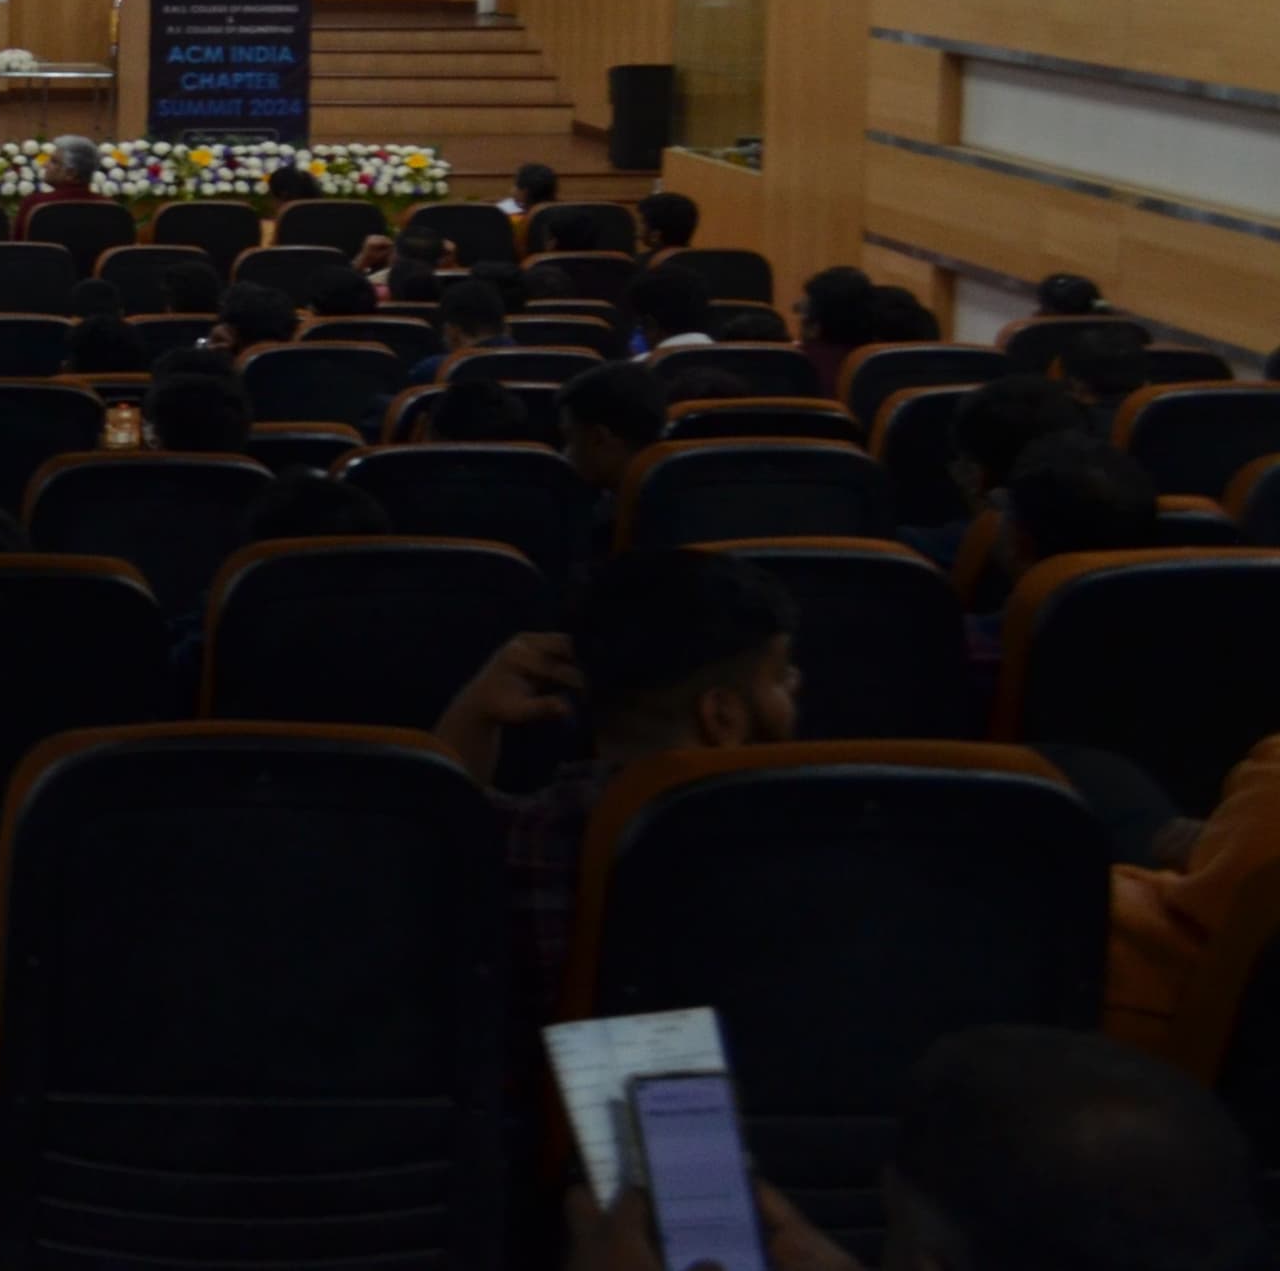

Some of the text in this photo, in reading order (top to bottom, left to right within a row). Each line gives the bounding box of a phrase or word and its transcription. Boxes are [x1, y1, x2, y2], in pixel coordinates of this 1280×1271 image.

[166, 45, 295, 63] ACM INDIA
[180, 72, 280, 90] CHAPTER
[158, 98, 304, 116] SUMMIT 2024
